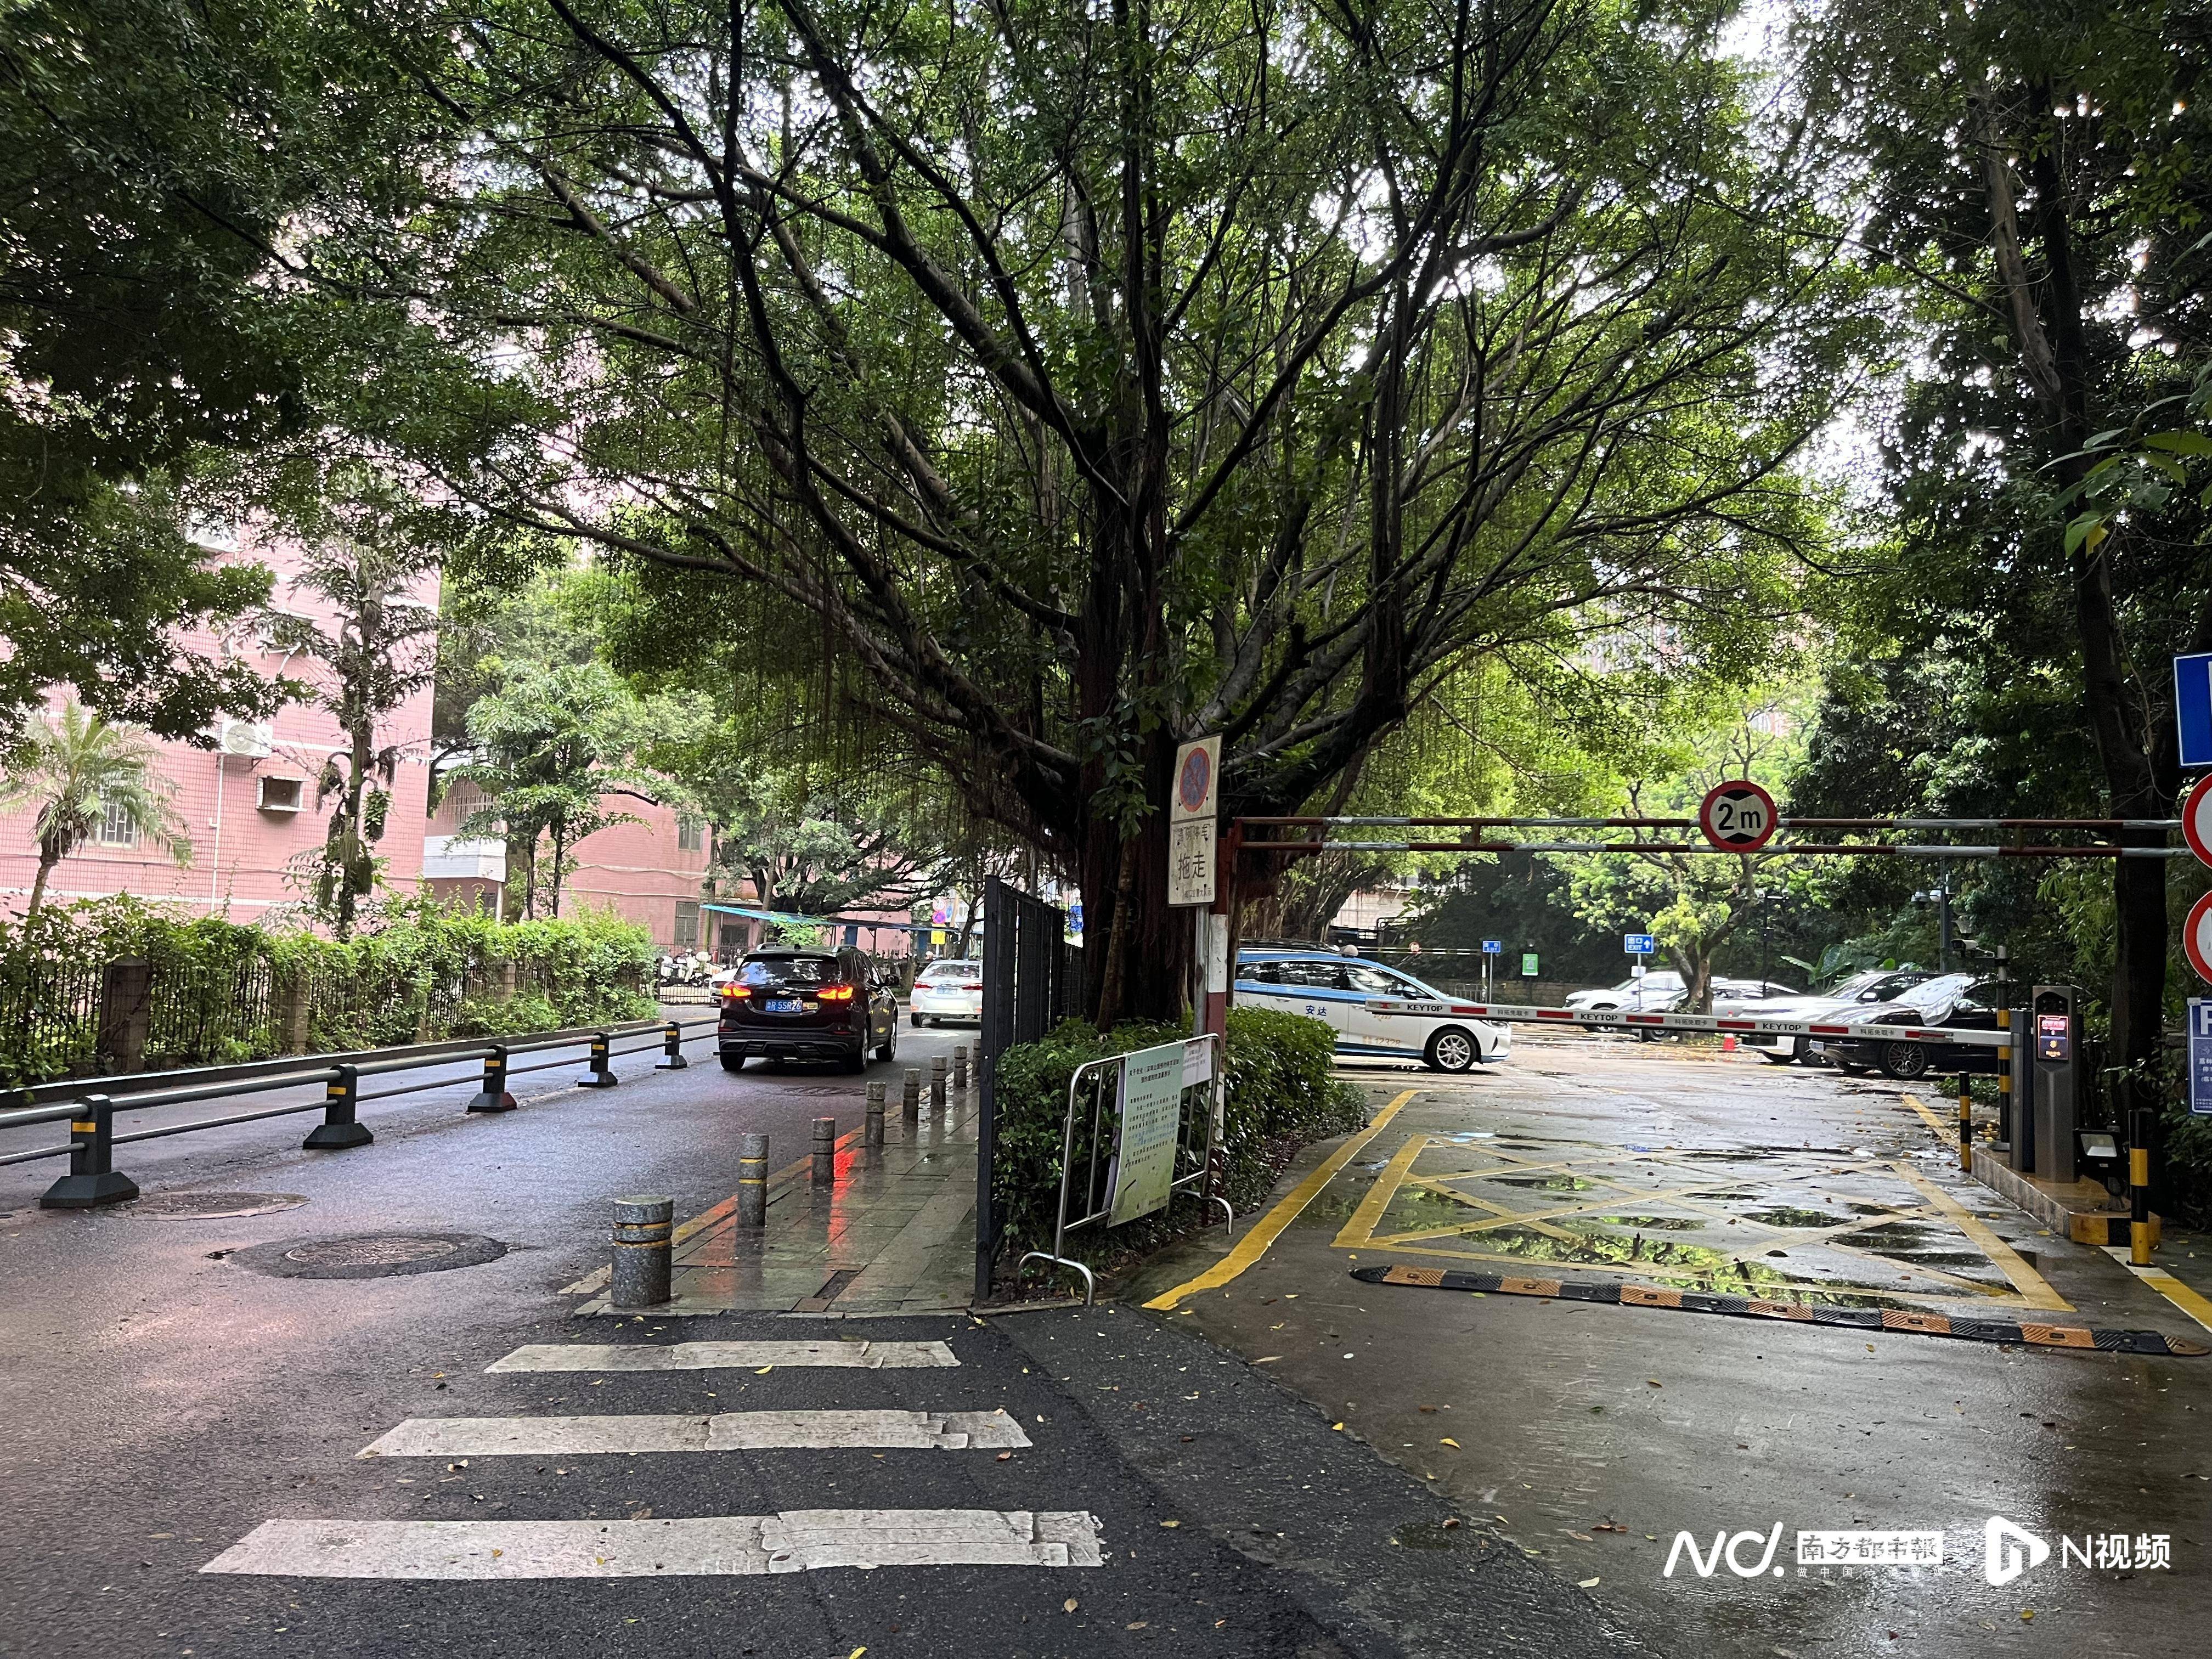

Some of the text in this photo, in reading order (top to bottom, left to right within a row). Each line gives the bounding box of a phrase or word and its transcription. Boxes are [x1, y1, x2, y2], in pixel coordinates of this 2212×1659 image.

[1178, 851, 1206, 881] 拖走
[1306, 1005, 1327, 1016] 安达
[1763, 1023, 1802, 1031] KEYTOP
